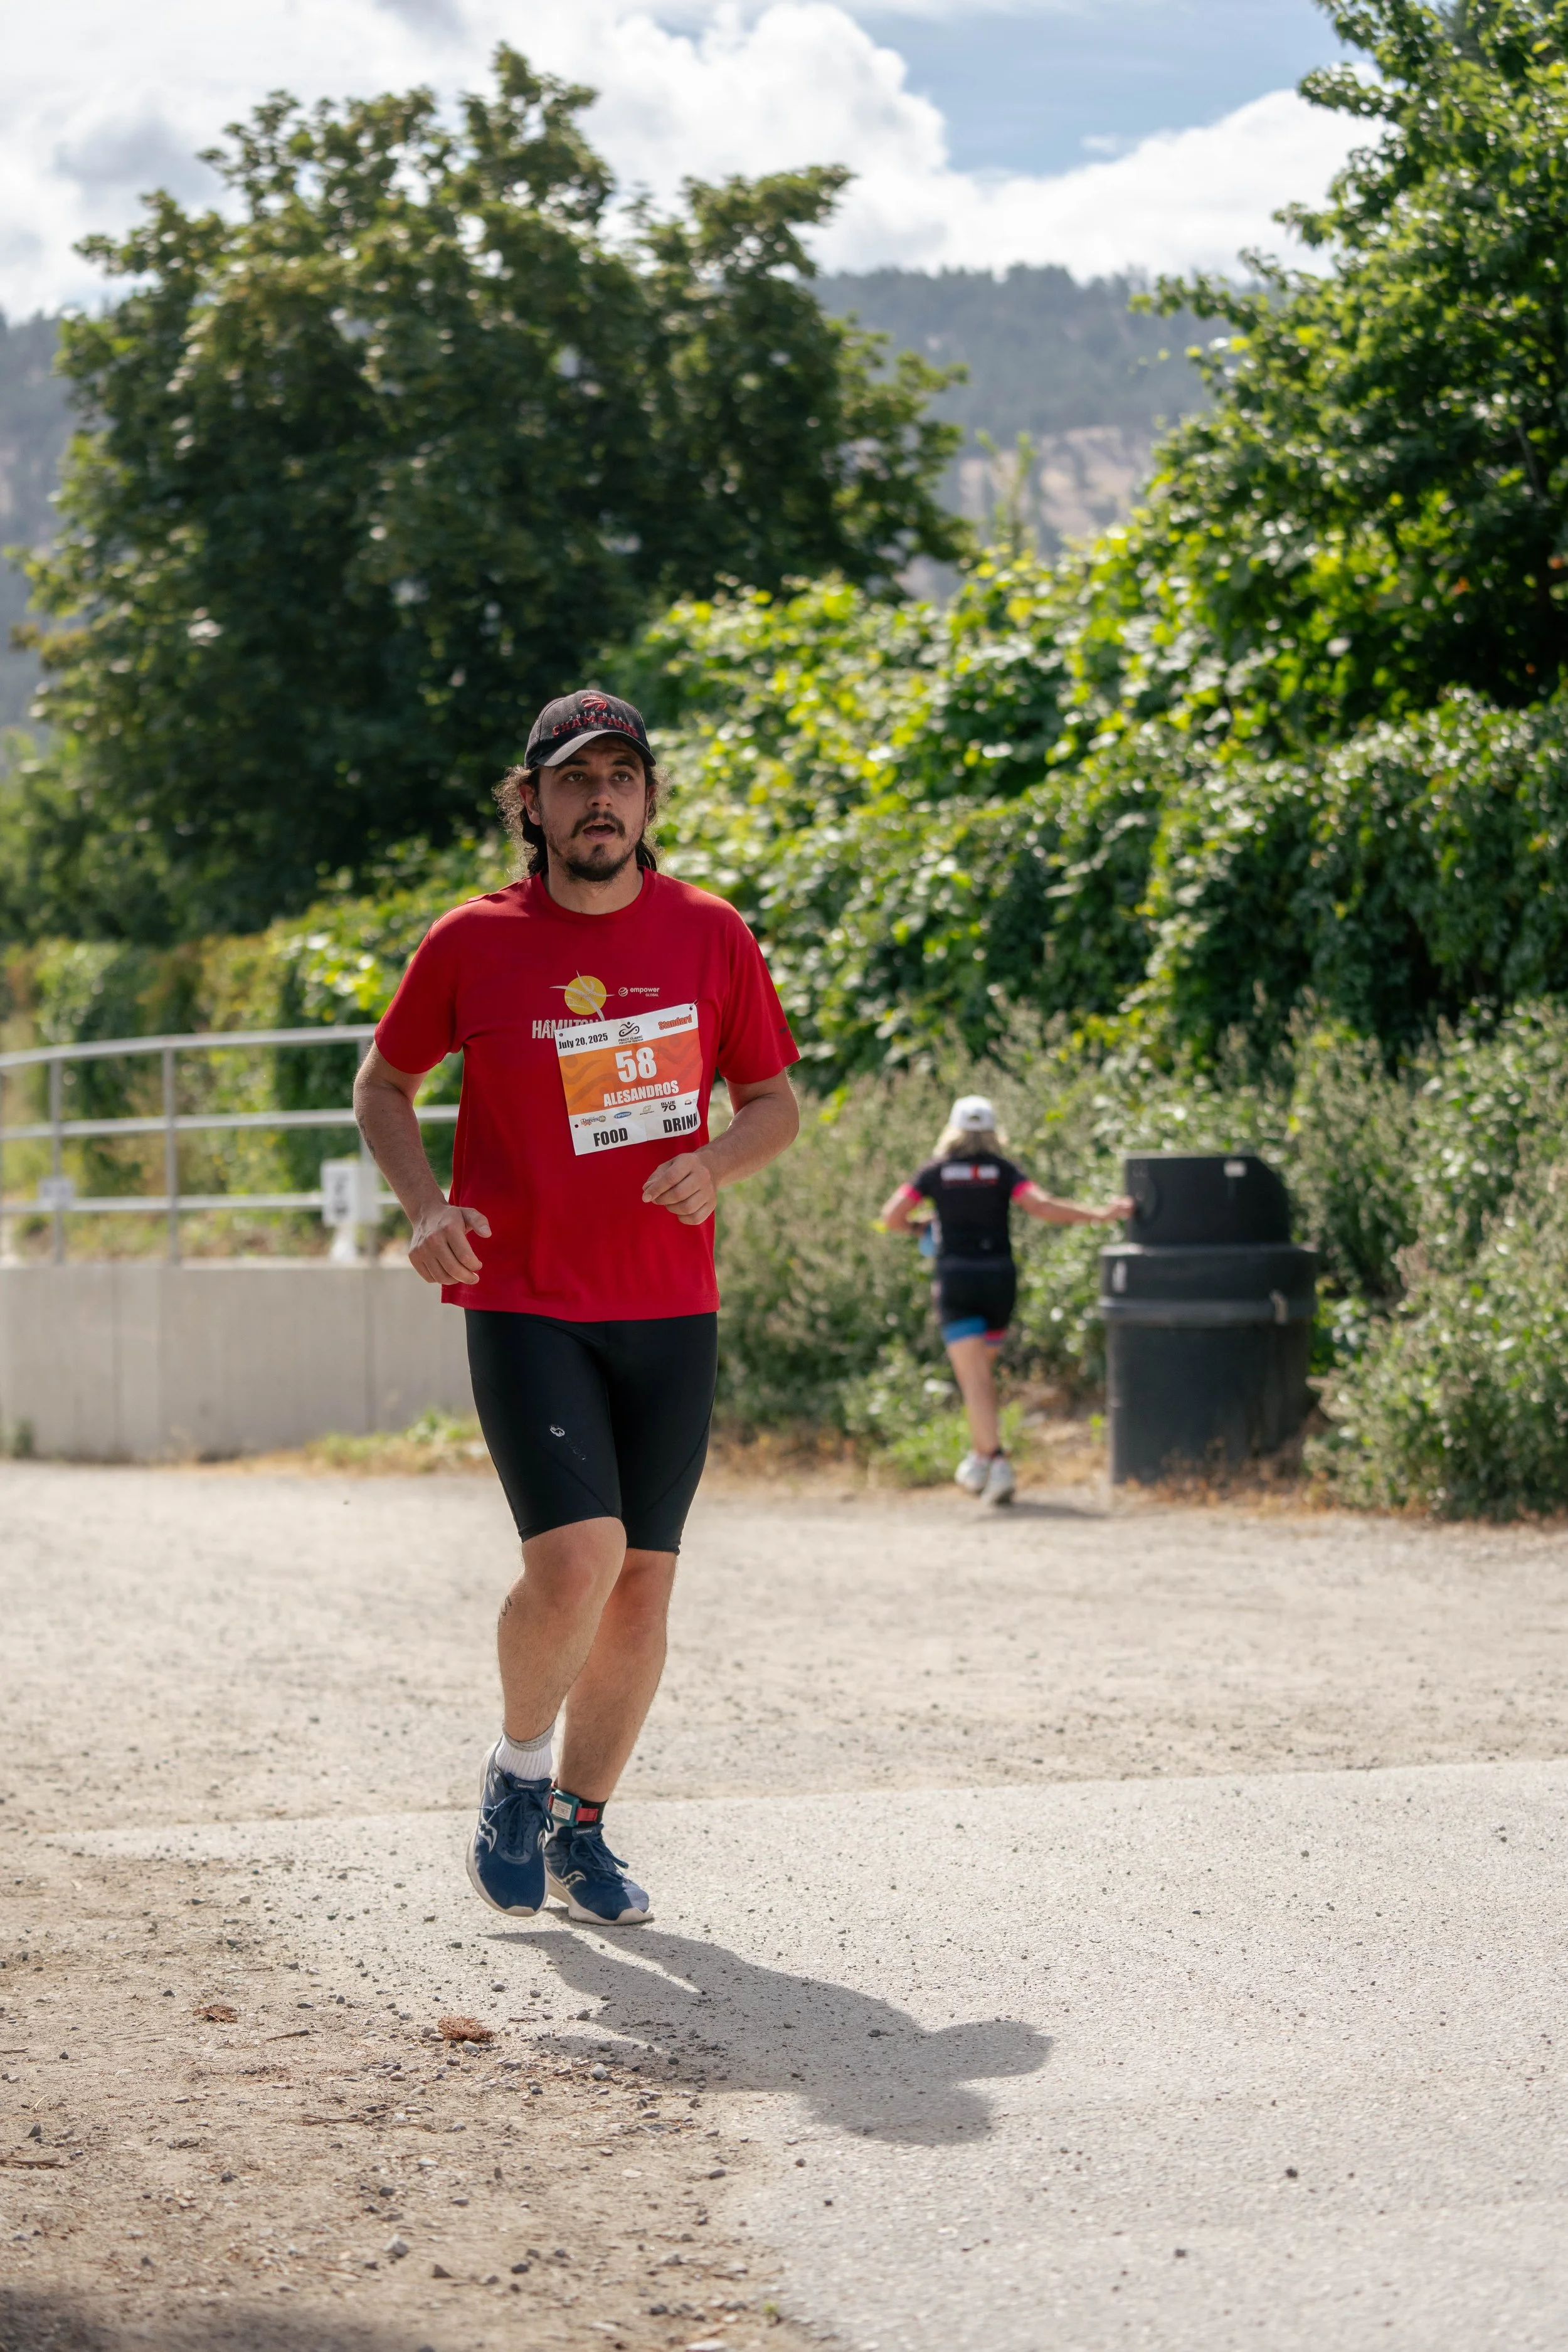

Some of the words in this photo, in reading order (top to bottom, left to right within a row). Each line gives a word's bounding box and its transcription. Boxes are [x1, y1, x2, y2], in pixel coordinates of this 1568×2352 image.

[552, 715, 639, 737] CHAMPIONS
[658, 1014, 692, 1030] Standard
[558, 1040, 575, 1049] July
[575, 1037, 588, 1047] 20,
[588, 1032, 608, 1044] 2025
[615, 1047, 657, 1083] 58
[603, 1080, 679, 1108] ALESANDROS
[661, 1104, 676, 1113] 70
[662, 1111, 697, 1134] DRINK
[593, 1128, 628, 1147] FOOD
